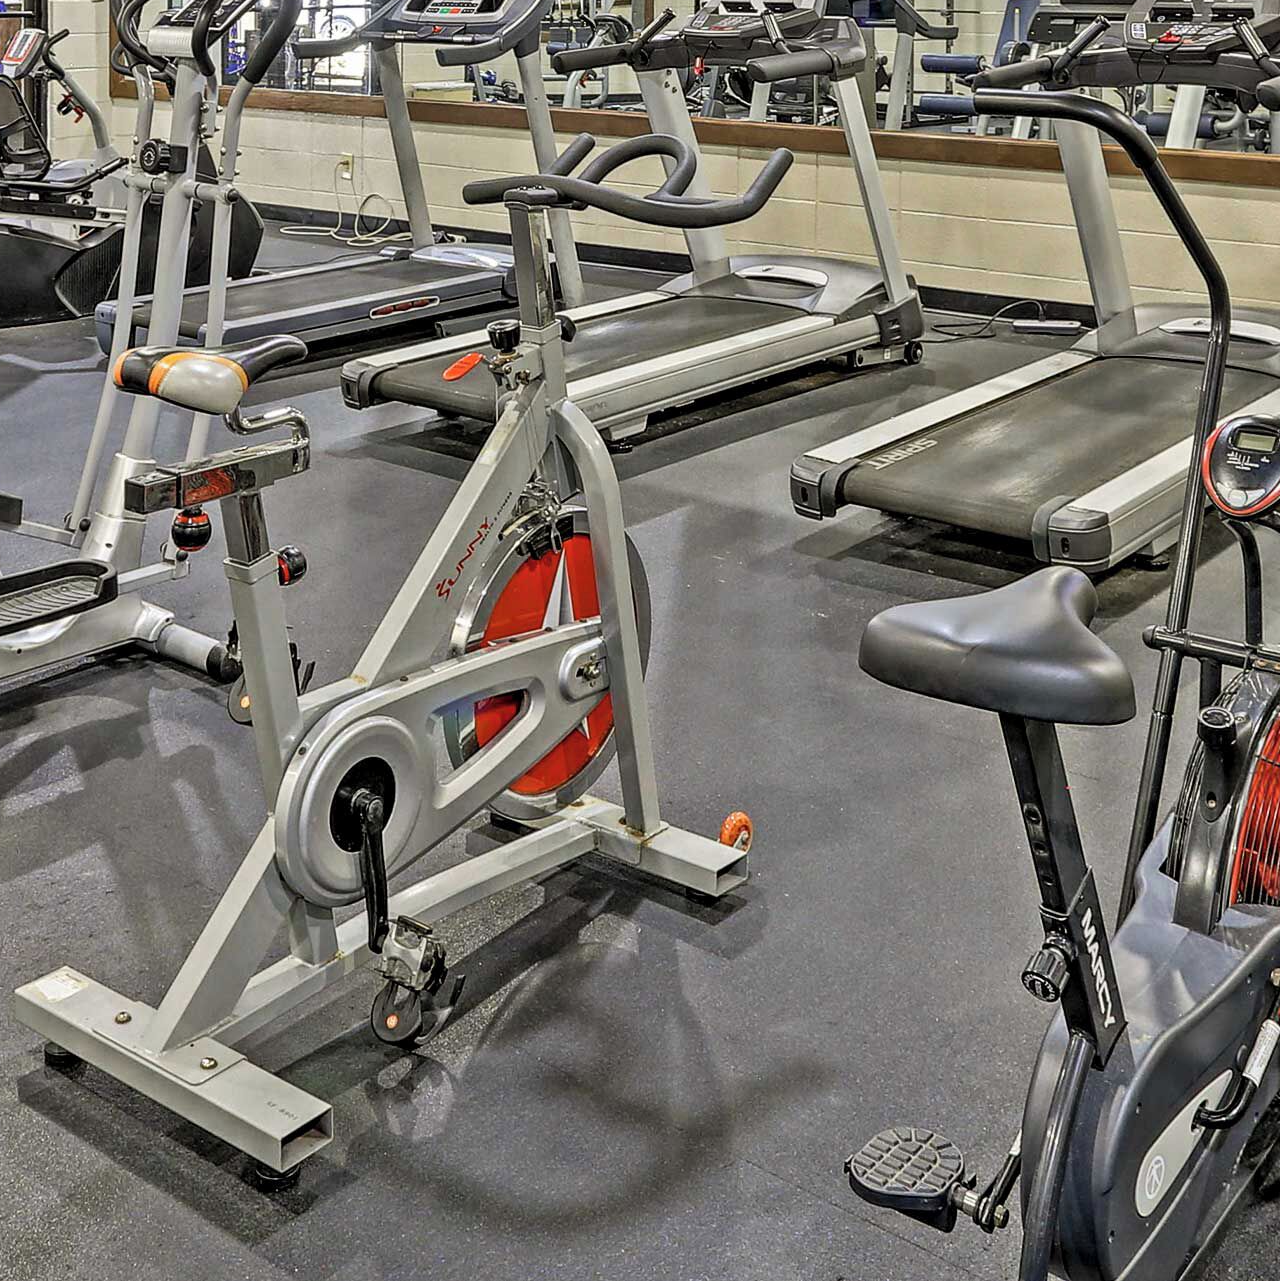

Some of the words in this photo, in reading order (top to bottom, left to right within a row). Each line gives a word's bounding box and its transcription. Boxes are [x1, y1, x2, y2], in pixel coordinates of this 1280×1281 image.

[864, 438, 938, 470] SPIRIT
[436, 517, 489, 602] SUNNY
[1082, 907, 1116, 1028] MARCY
